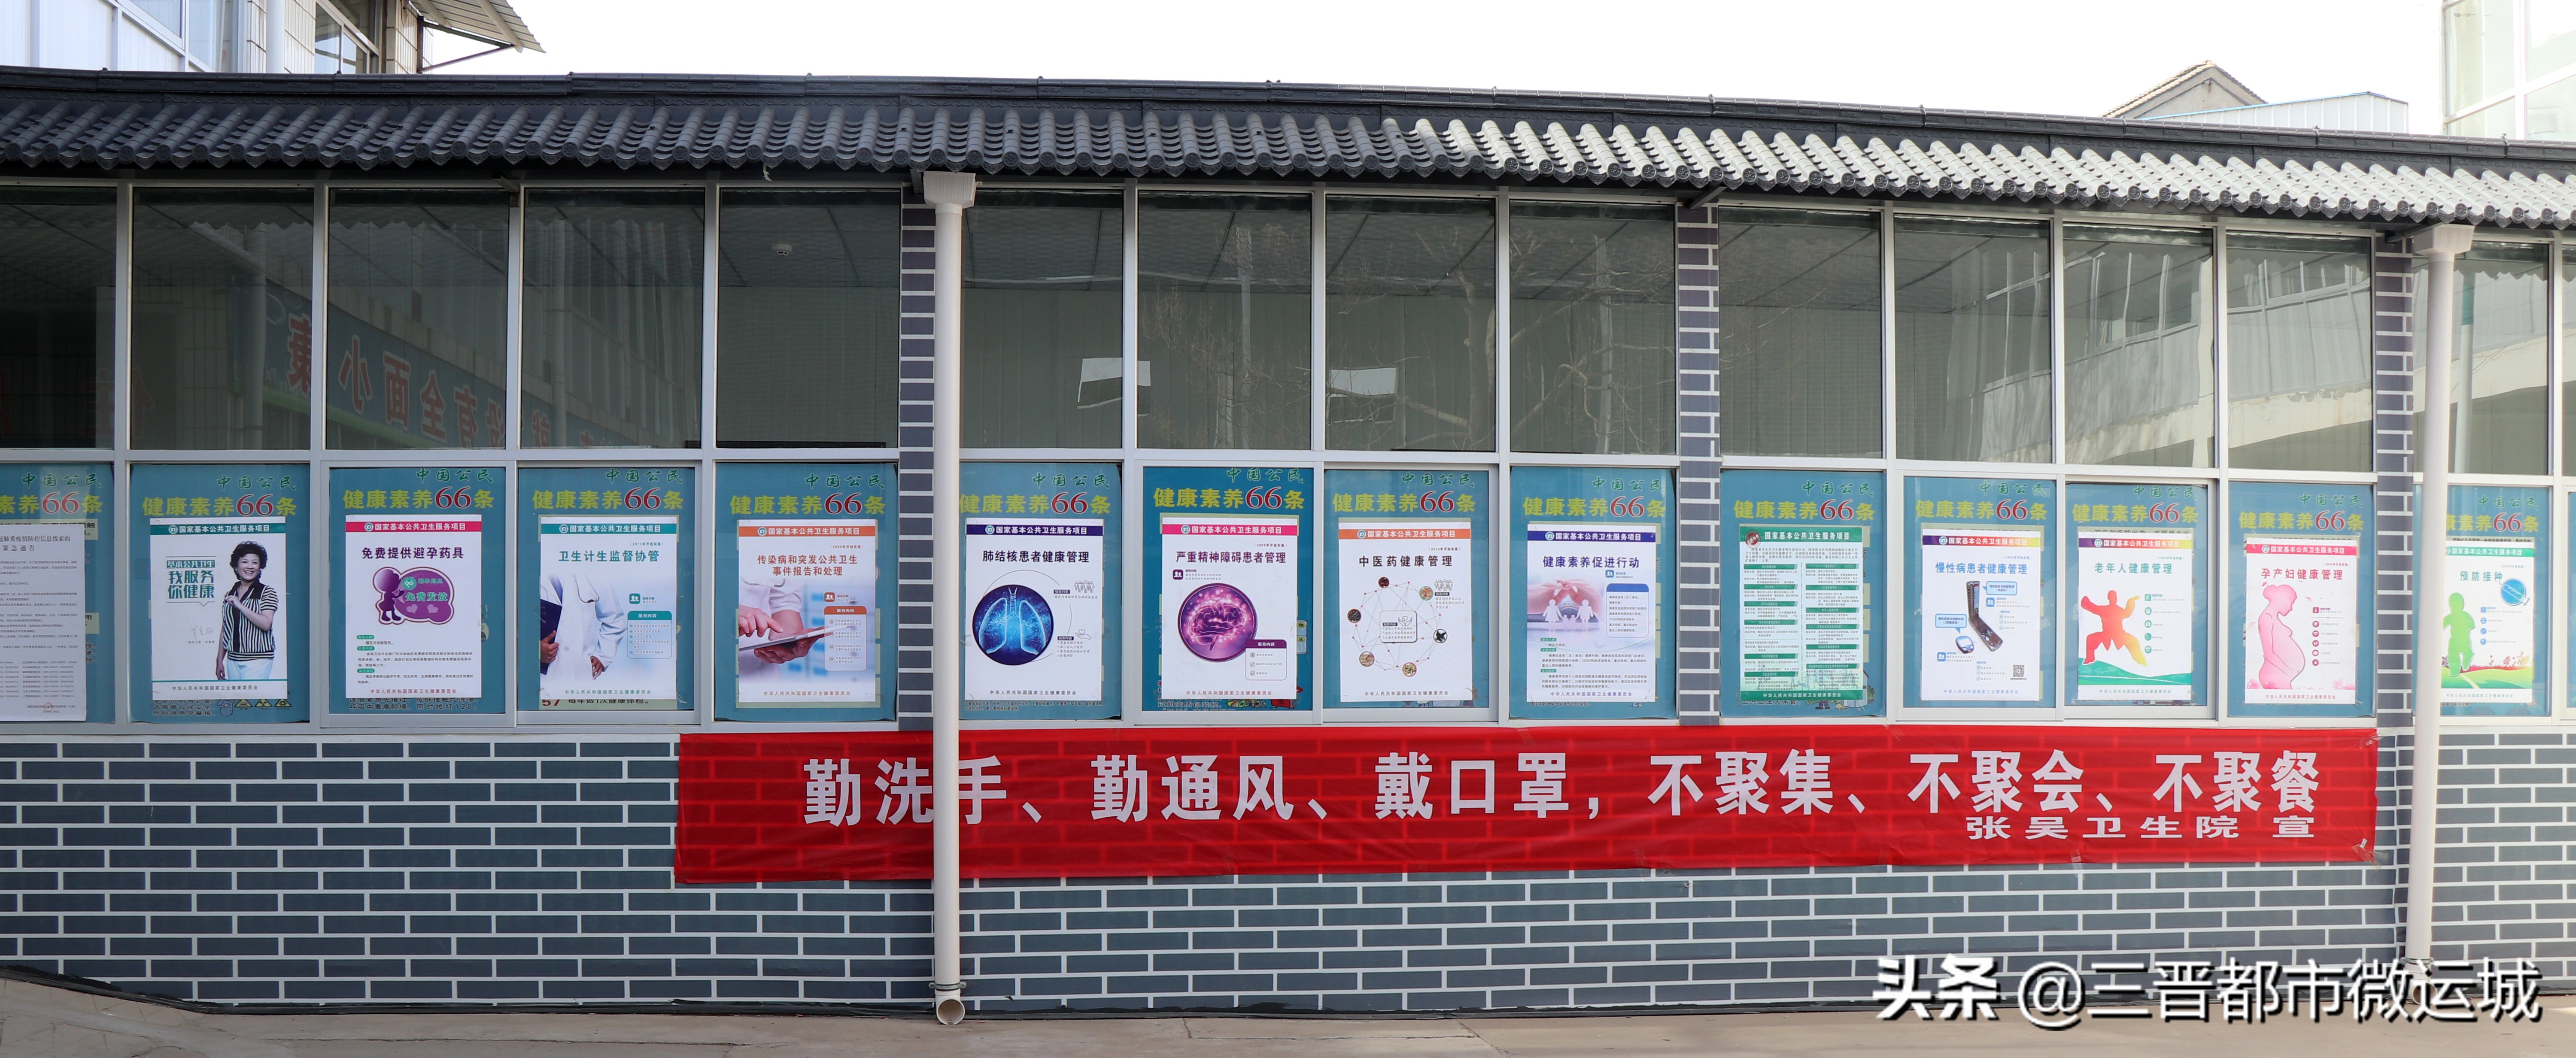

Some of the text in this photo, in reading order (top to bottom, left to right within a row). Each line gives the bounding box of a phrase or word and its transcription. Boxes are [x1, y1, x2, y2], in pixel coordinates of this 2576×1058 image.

[22, 473, 102, 489] 中国公民
[217, 474, 296, 491] 中国公民
[416, 468, 493, 483] 中国公民
[605, 468, 683, 484] 中国公民
[805, 473, 885, 489] 中国公民
[1032, 472, 1110, 489] 中国公民
[1227, 467, 1304, 484] 中国公民
[1401, 472, 1475, 488] 中国公民
[1592, 476, 1665, 494] 中国公民
[1801, 480, 1874, 497] 中国公民
[1979, 480, 2047, 496] 中国公民
[2132, 485, 2197, 500] 中国公民
[142, 494, 297, 516] 健康素养66条
[343, 486, 494, 509] 健康素养66条
[532, 487, 684, 510] 健康素养66条
[729, 492, 886, 515] 健康素养66条
[960, 491, 1111, 514] 健康素养66条
[1153, 486, 1305, 509] 健康素养66条
[1332, 490, 1476, 513] 健康素养66条
[2299, 493, 2363, 508] 中国公民
[2478, 495, 2538, 510] 中国公民
[1523, 496, 1665, 518] 健康素养66条
[1734, 499, 1875, 521] 健康素养66条
[1915, 499, 2047, 521] 健康素养66条
[2072, 503, 2199, 523] 健康素养66条
[375, 523, 466, 531] 国家基本公共卫生服务项目
[2239, 510, 2364, 531] 健康素养66条
[179, 524, 270, 533] 国家基本公共卫生服务项目
[996, 526, 1088, 535] 国家基本公共卫生服务项目
[1191, 526, 1282, 534] 国家基本公共卫生服务项目
[1765, 531, 1850, 540] 国家基本公共卫生服务项目
[1555, 533, 1642, 541] 国家基本公共卫生服务项目
[1948, 537, 2027, 546] 国家基本公共卫生服务项目
[2103, 540, 2179, 548] 国家基本公共卫生服务项目
[361, 547, 464, 559] 免费提供避孕药具
[558, 550, 660, 562] 卫生计生监督协管
[982, 550, 1090, 563] 肺结核患者健康管理
[1176, 551, 1286, 564] 严重精神障碍患者管理
[2270, 546, 2345, 554] 国家基本公共卫生服务项目
[2451, 548, 2522, 556] 国家基本公共卫生服务项目
[167, 560, 215, 568] 基本公共卫生
[757, 555, 858, 565] 传染病和突发公共卫生
[1358, 555, 1453, 567] 中医药健康管理
[1543, 556, 1640, 569] 健康素养促进行动
[772, 566, 843, 576] 事件报告和处理
[1935, 562, 2027, 574] 慢性病患者健康管理
[2094, 562, 2173, 574] 老年人健康管理
[2261, 568, 2343, 580] 孕产妇健康管理
[168, 570, 215, 584] 我服务
[2459, 571, 2503, 582] 预防接种
[167, 584, 215, 599] 你健康
[405, 591, 448, 602] 免费发放
[1966, 815, 2316, 840] 张吴卫生院 宣
